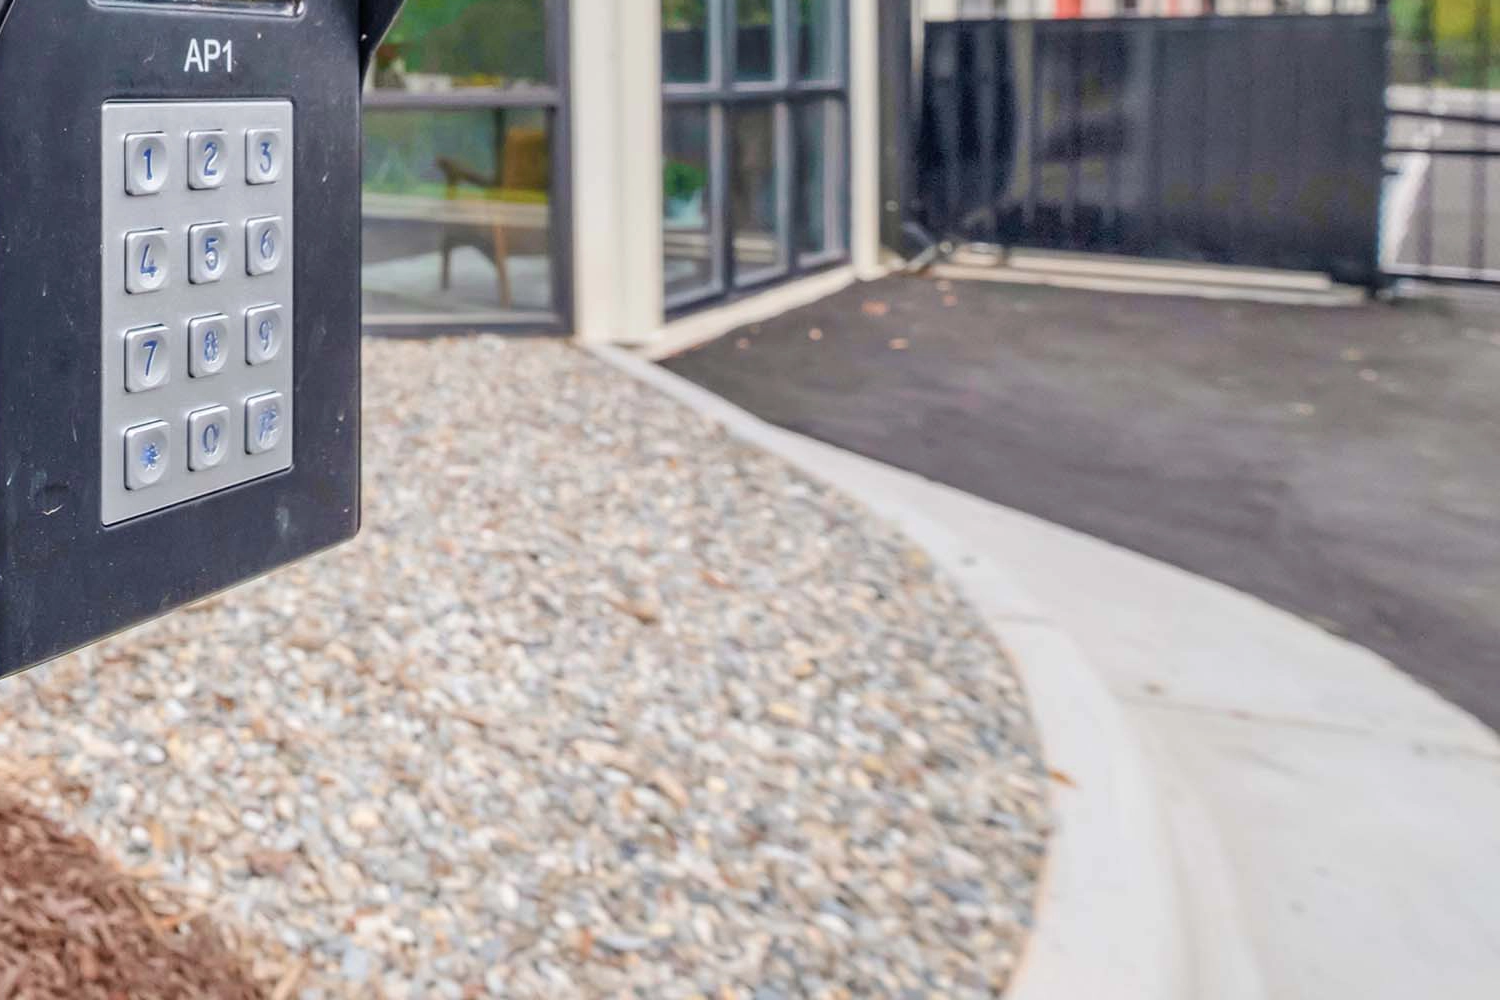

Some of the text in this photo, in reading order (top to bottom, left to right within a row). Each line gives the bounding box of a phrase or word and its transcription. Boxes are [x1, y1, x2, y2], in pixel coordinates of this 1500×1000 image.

[184, 38, 232, 73] AP1
[143, 141, 272, 180] 1 2 3
[140, 228, 275, 278] 4 5 6
[142, 319, 274, 377] 7 8 9
[202, 423, 220, 455] 0
